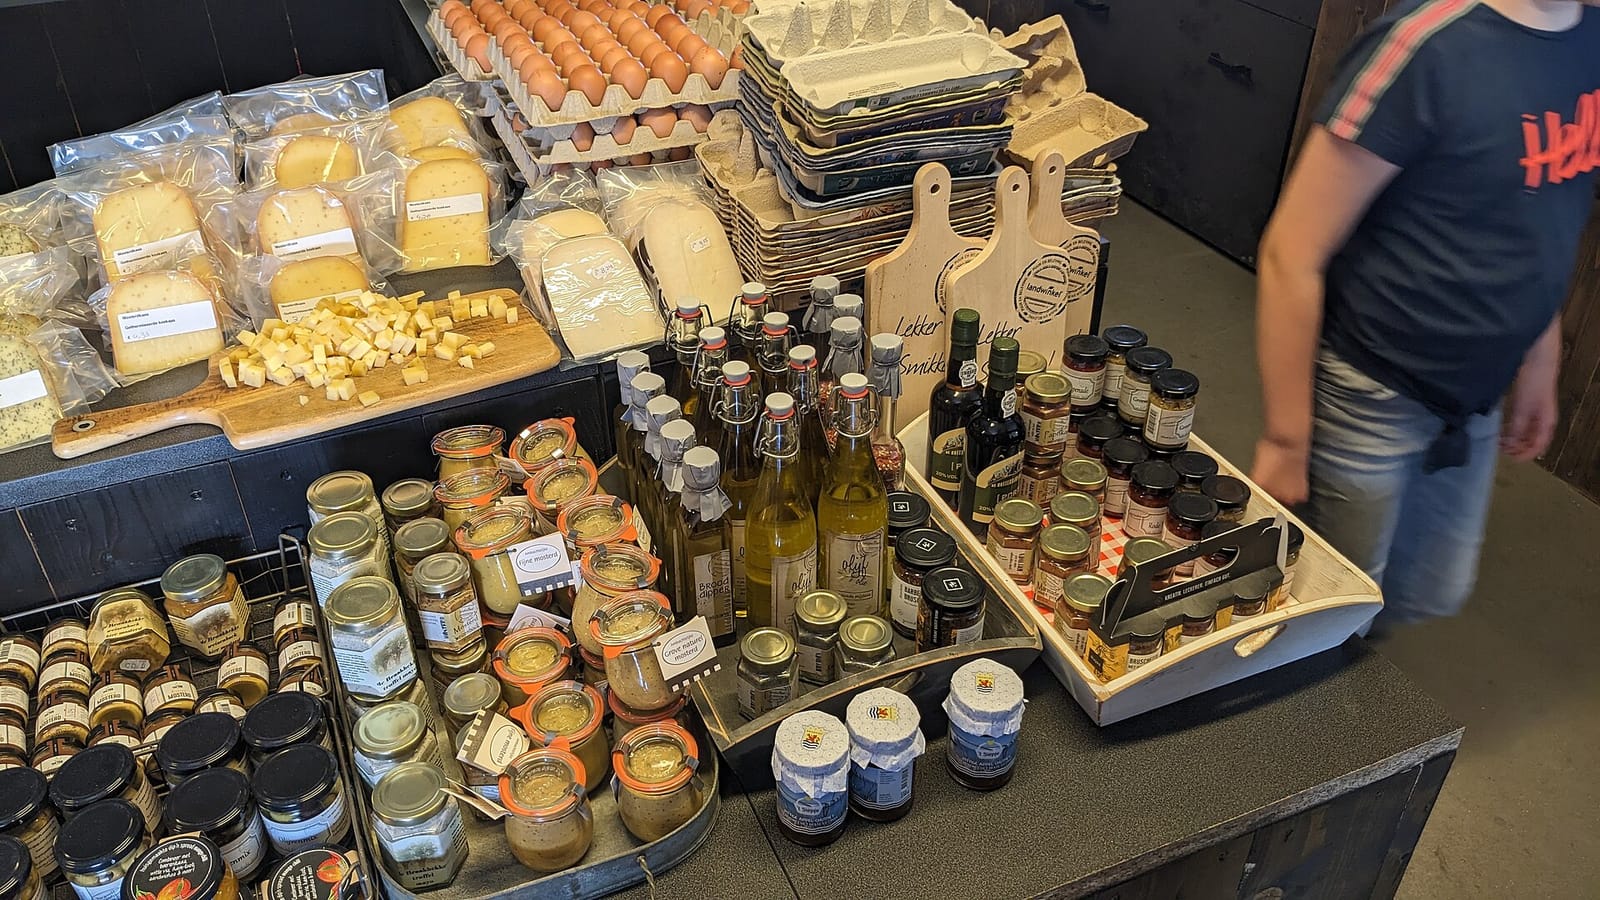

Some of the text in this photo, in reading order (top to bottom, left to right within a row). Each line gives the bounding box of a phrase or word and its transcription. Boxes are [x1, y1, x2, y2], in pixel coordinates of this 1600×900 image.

[1026, 282, 1064, 299] landwinkel
[895, 315, 944, 338] Lekker
[977, 321, 1023, 346] Lekker
[664, 646, 682, 658] Grove
[674, 645, 698, 661] mosterd
